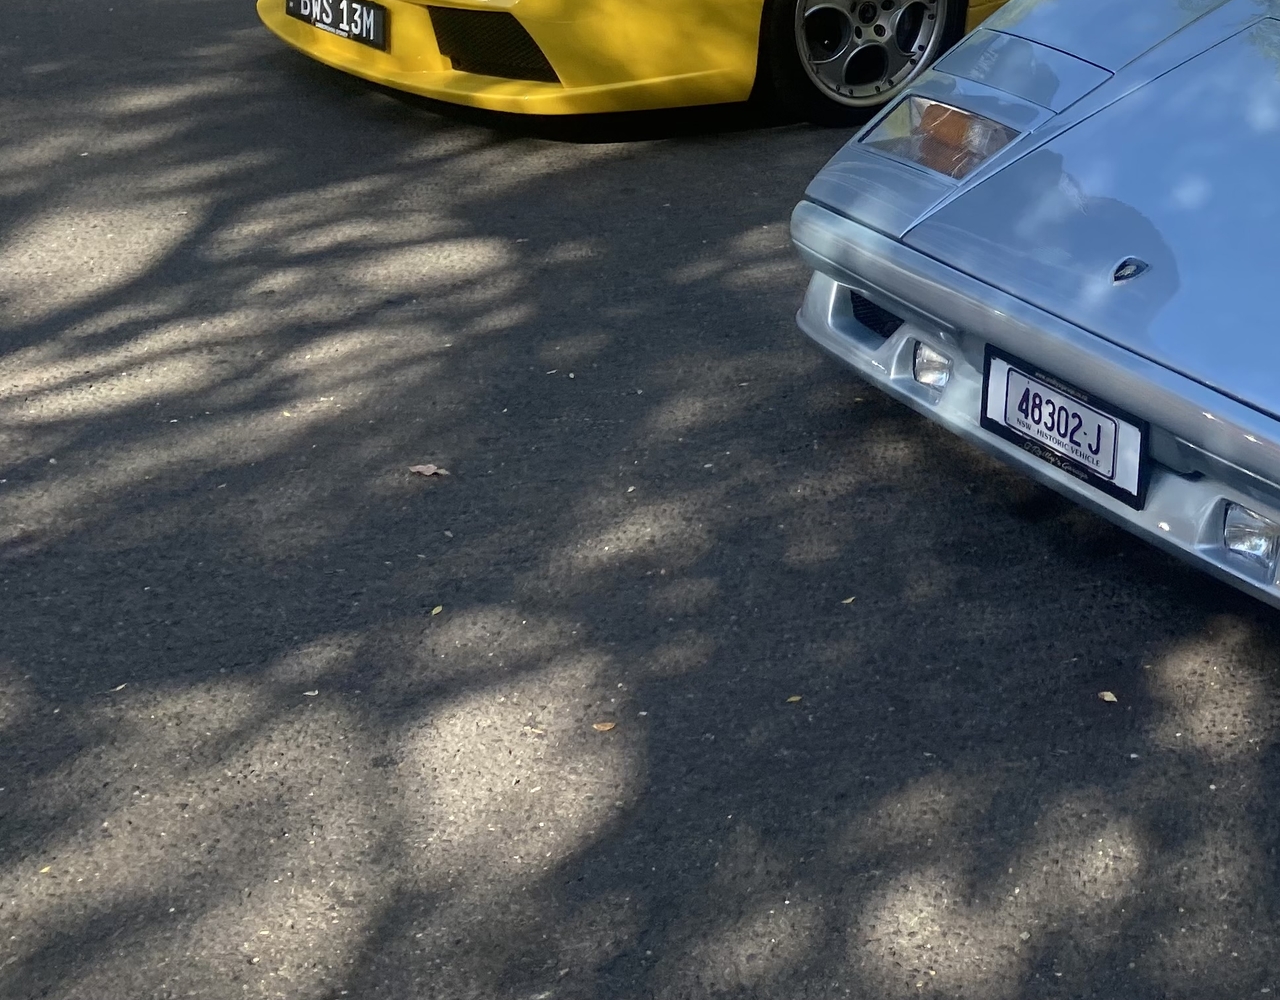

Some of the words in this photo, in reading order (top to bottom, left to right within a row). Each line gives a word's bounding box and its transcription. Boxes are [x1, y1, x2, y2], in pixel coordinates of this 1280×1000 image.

[339, 0, 374, 40] 13M
[1016, 418, 1032, 431] NSW
[1036, 428, 1069, 450] HISTORIC
[1070, 446, 1101, 467] VEHICLE
